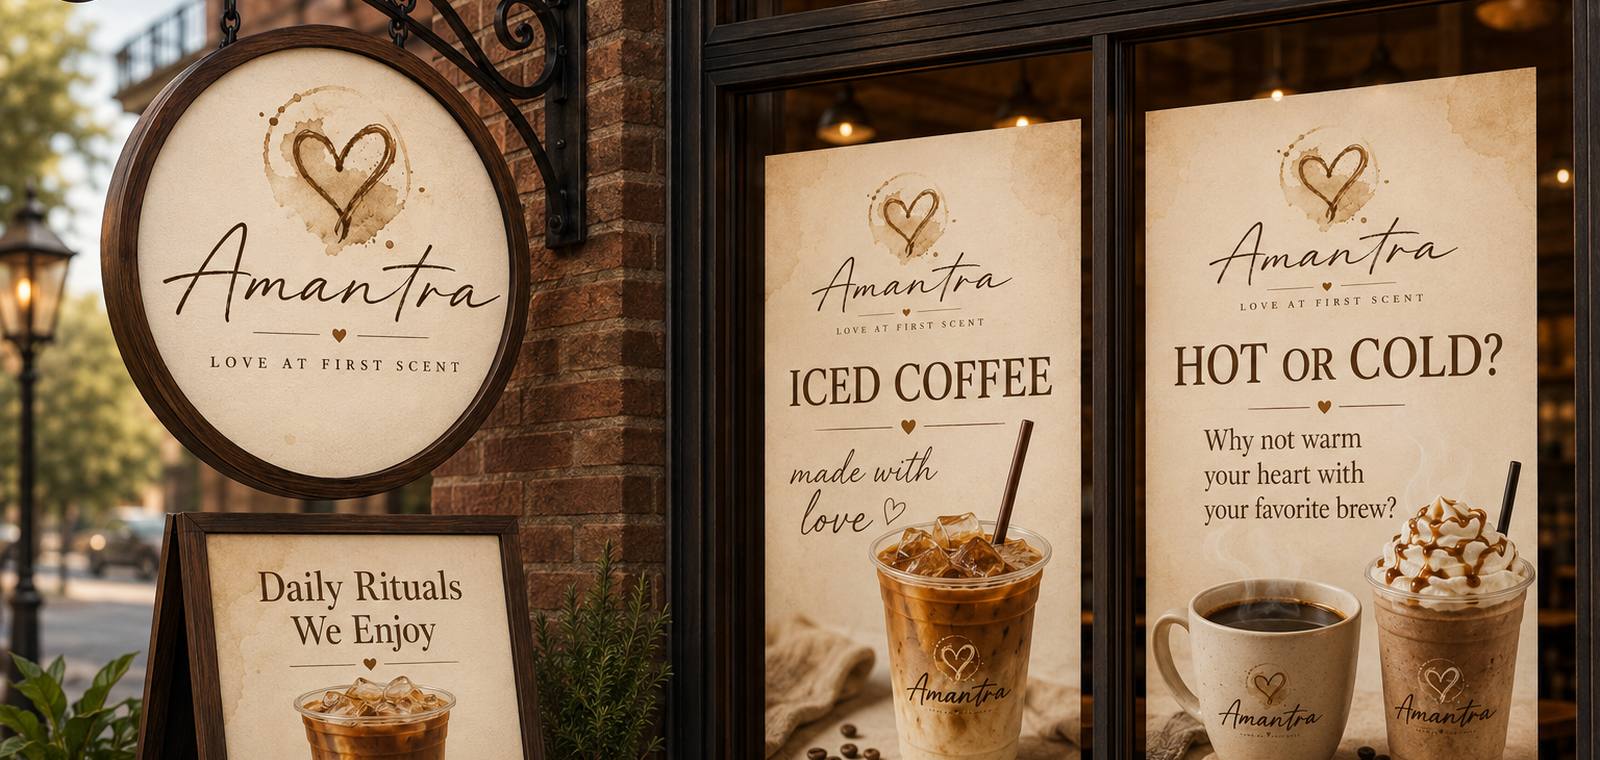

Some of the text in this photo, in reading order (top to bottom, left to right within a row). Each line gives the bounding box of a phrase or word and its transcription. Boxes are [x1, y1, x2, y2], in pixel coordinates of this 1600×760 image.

[1209, 217, 1459, 286] Amantra
[162, 222, 501, 323] Amantra
[811, 252, 1013, 313] Amantra
[1239, 292, 1424, 312] LOVE AT FIRST SCENT
[836, 317, 985, 336] LOVE AT FIRST SCENT
[209, 355, 460, 373] LOVE AT FIRST SCENT
[1173, 332, 1503, 387] HOT OR COLD?
[789, 355, 1053, 407] ICED COFFEE
[1203, 427, 1363, 458] Why not warm
[789, 445, 939, 485] made with
[1203, 459, 1365, 493] your heart with
[800, 488, 875, 536] love
[1203, 495, 1397, 527] your favorite brew?
[257, 569, 463, 609] Daily Rituals
[289, 614, 437, 653] We Enjoy
[906, 672, 1011, 707] Amantra
[1217, 698, 1324, 730] Amantra
[1394, 693, 1498, 728] Amantra
